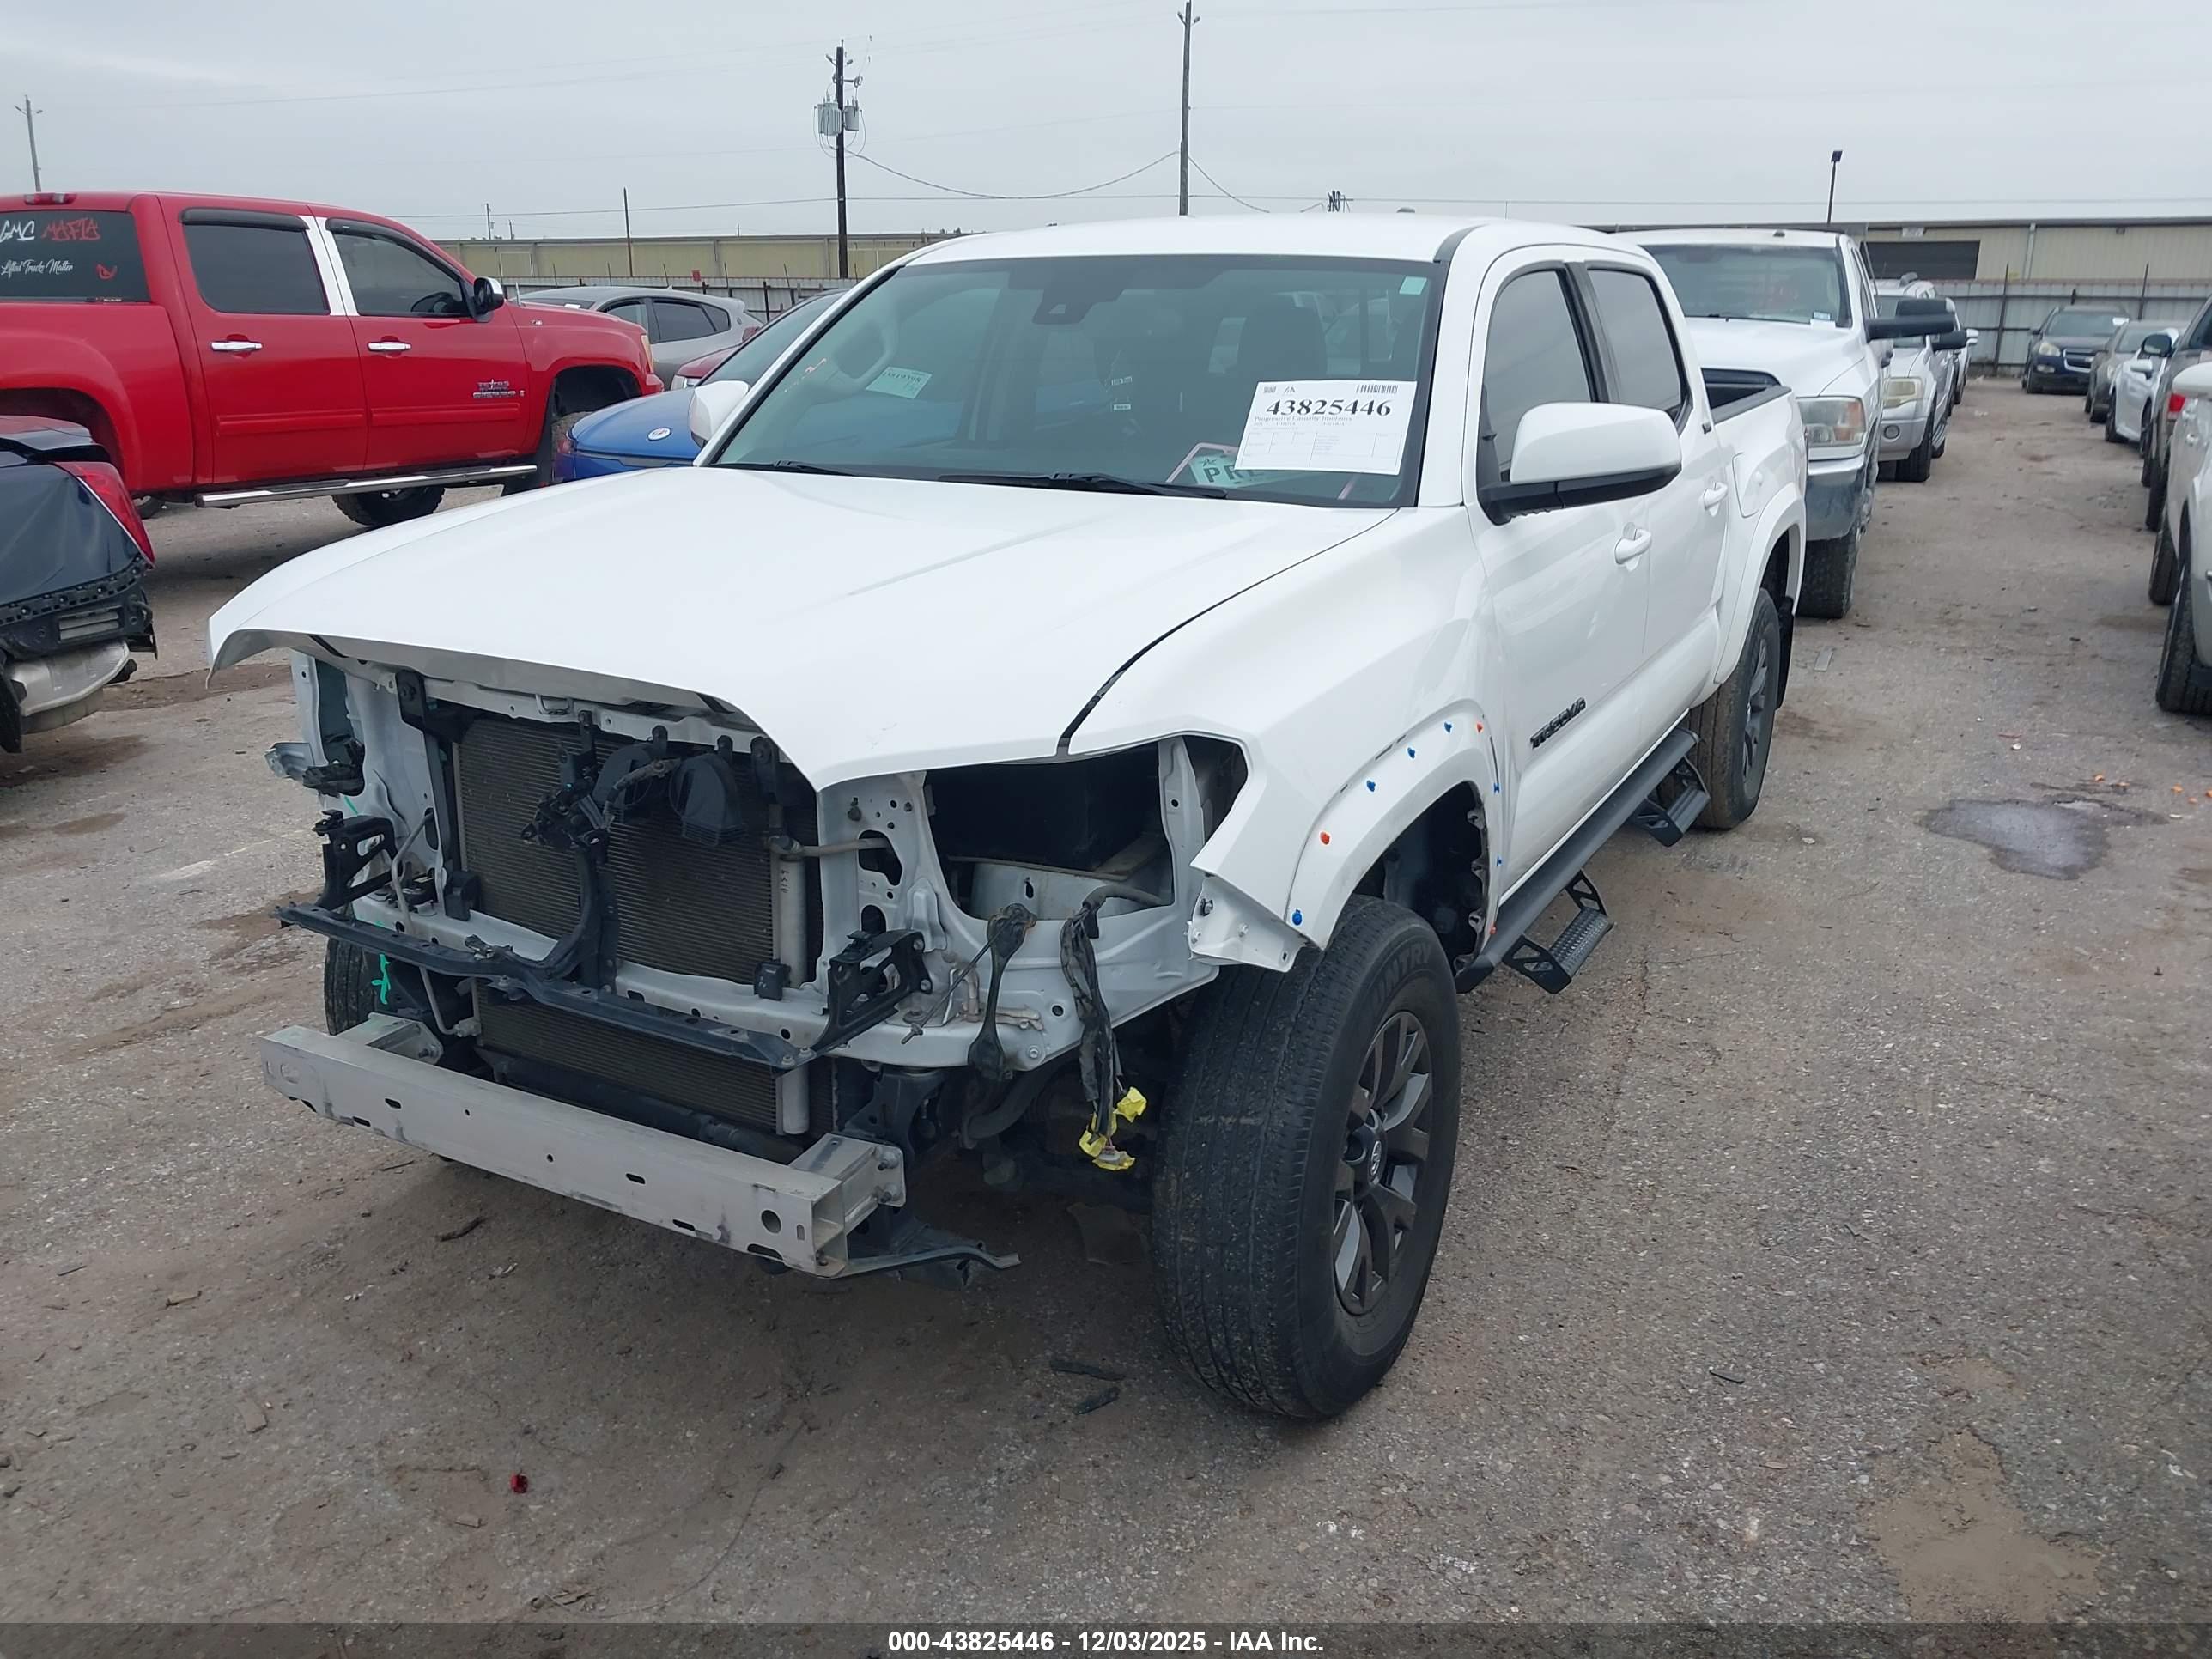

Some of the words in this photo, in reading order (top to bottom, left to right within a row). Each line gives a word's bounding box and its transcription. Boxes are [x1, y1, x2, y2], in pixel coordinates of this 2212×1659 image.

[0, 220, 35, 243] GMC
[41, 217, 101, 241] MAFIA
[46, 258, 74, 276] Matter
[1267, 398, 1392, 416] 43825446
